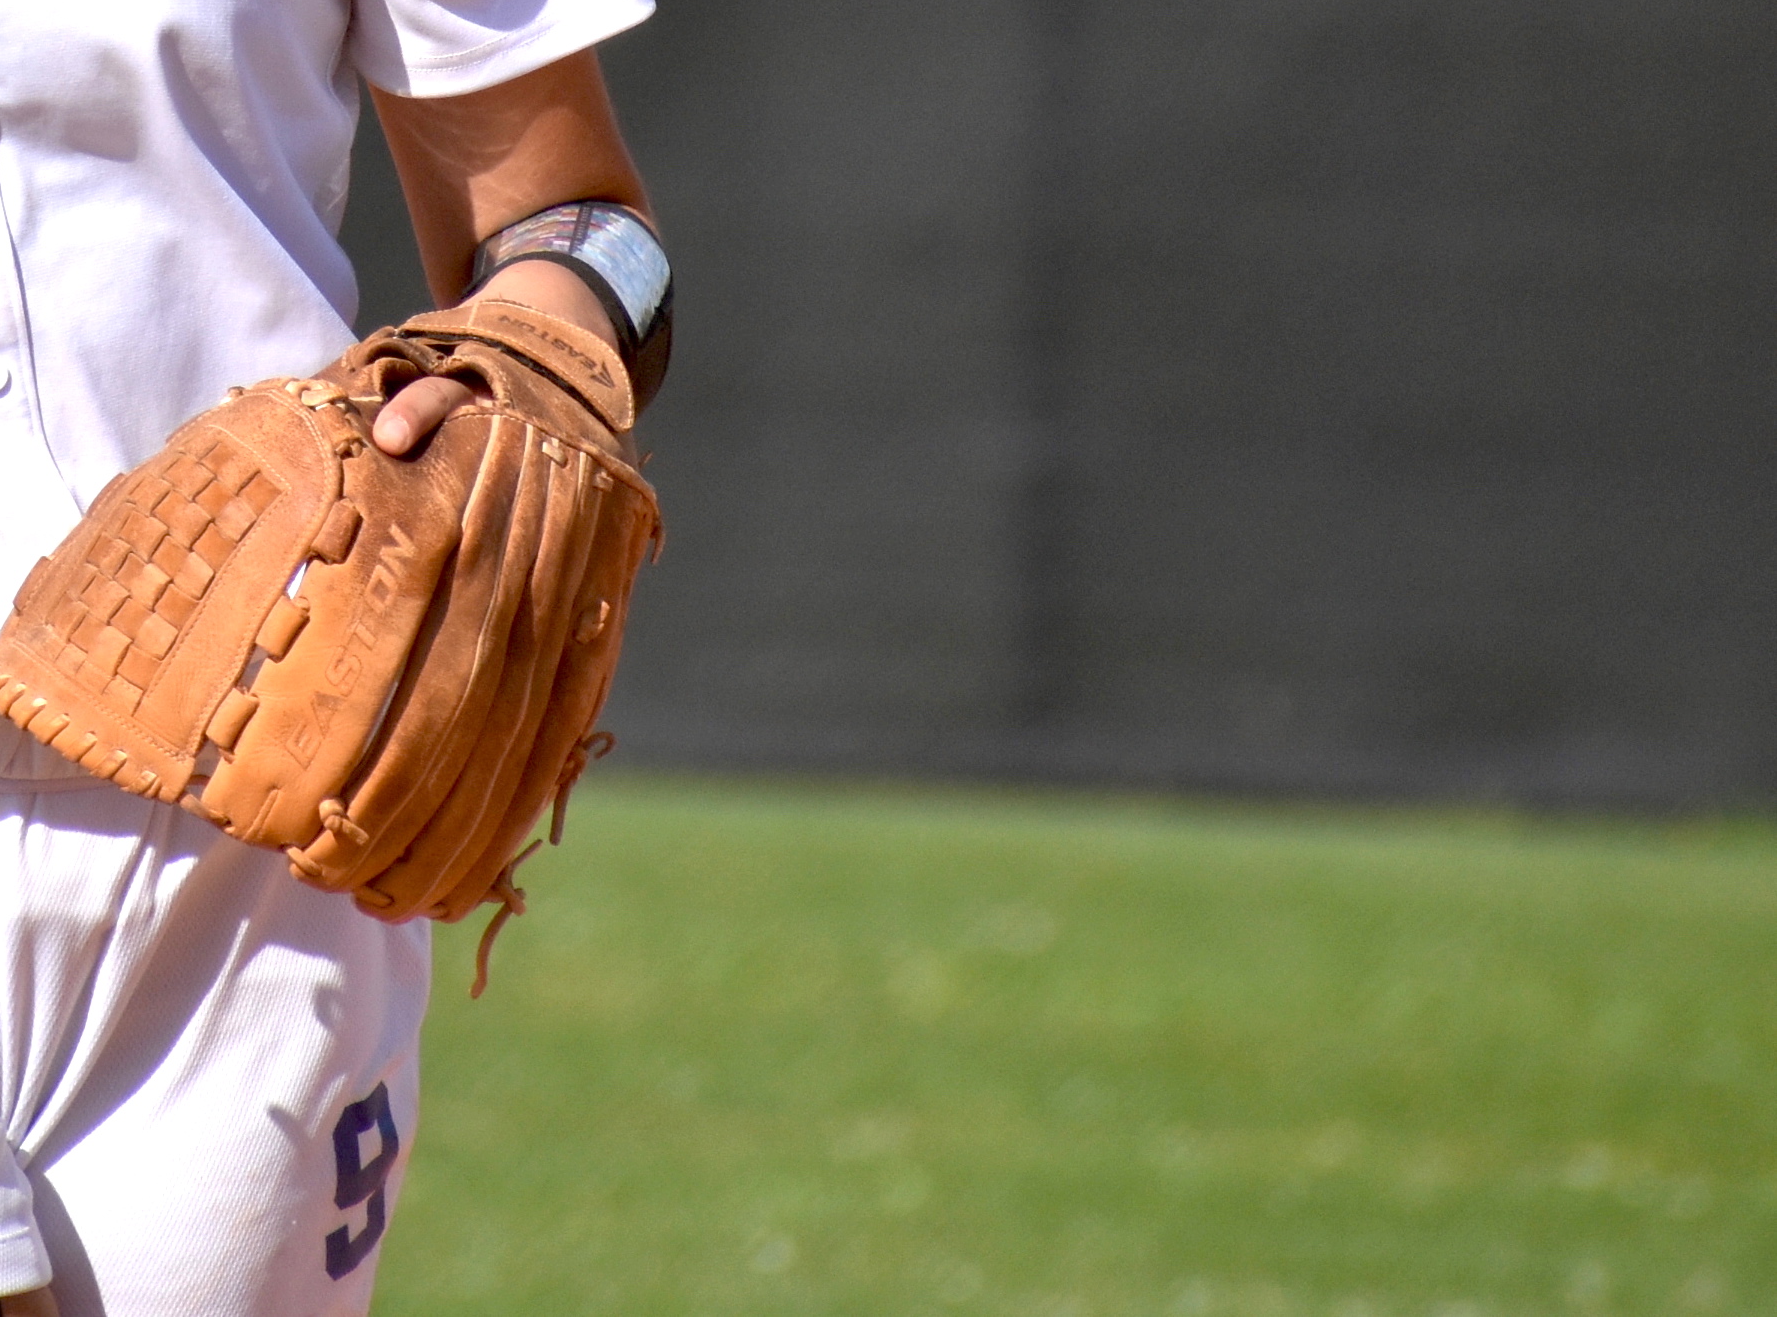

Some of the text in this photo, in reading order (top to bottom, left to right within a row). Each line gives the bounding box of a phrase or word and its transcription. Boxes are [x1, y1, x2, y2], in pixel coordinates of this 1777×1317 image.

[498, 315, 598, 370] EASTON
[282, 523, 420, 770] EASTON
[325, 1080, 399, 1281] 9
